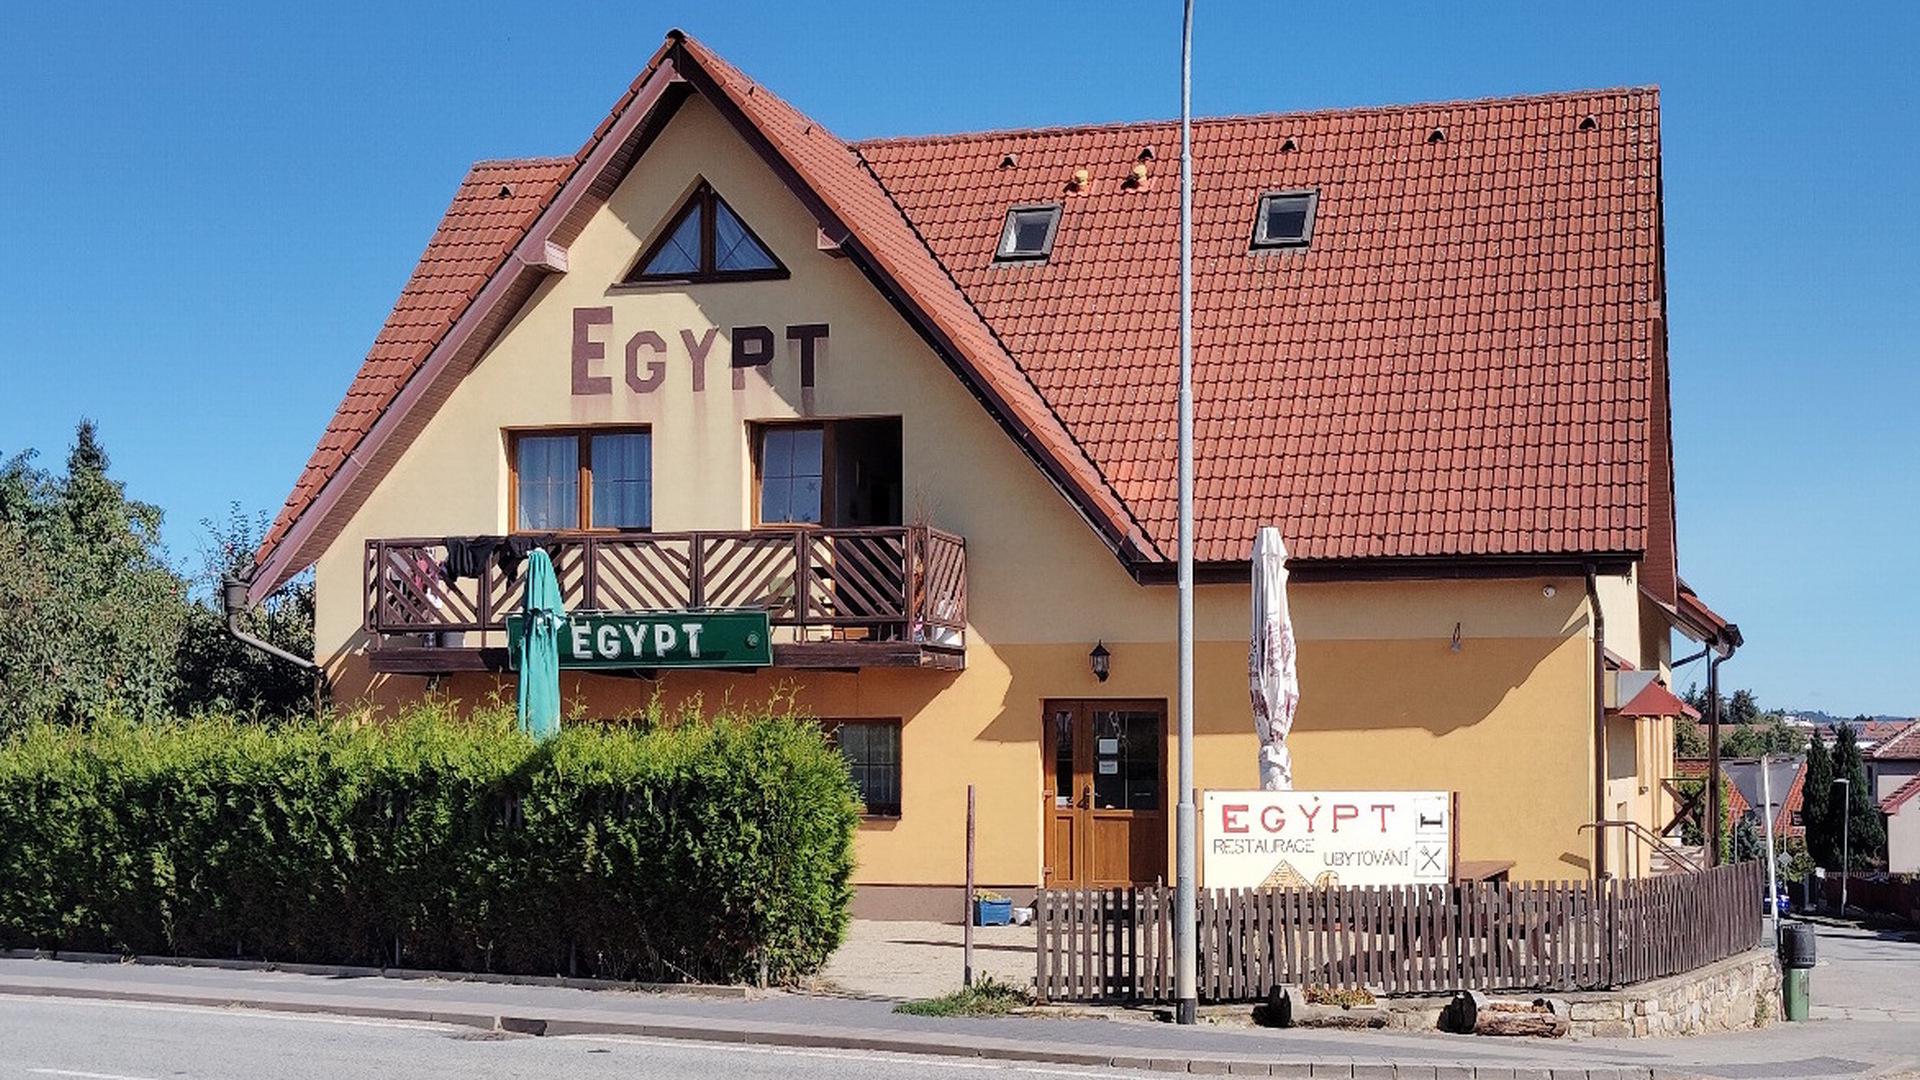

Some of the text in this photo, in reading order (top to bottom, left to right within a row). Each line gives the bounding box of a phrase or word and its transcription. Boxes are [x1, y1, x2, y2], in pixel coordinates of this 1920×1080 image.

[571, 306, 829, 395] EGYPT
[572, 622, 703, 660] EGYPT
[1222, 804, 1395, 833] EGYPT
[1213, 838, 1315, 854] RESTAURACE
